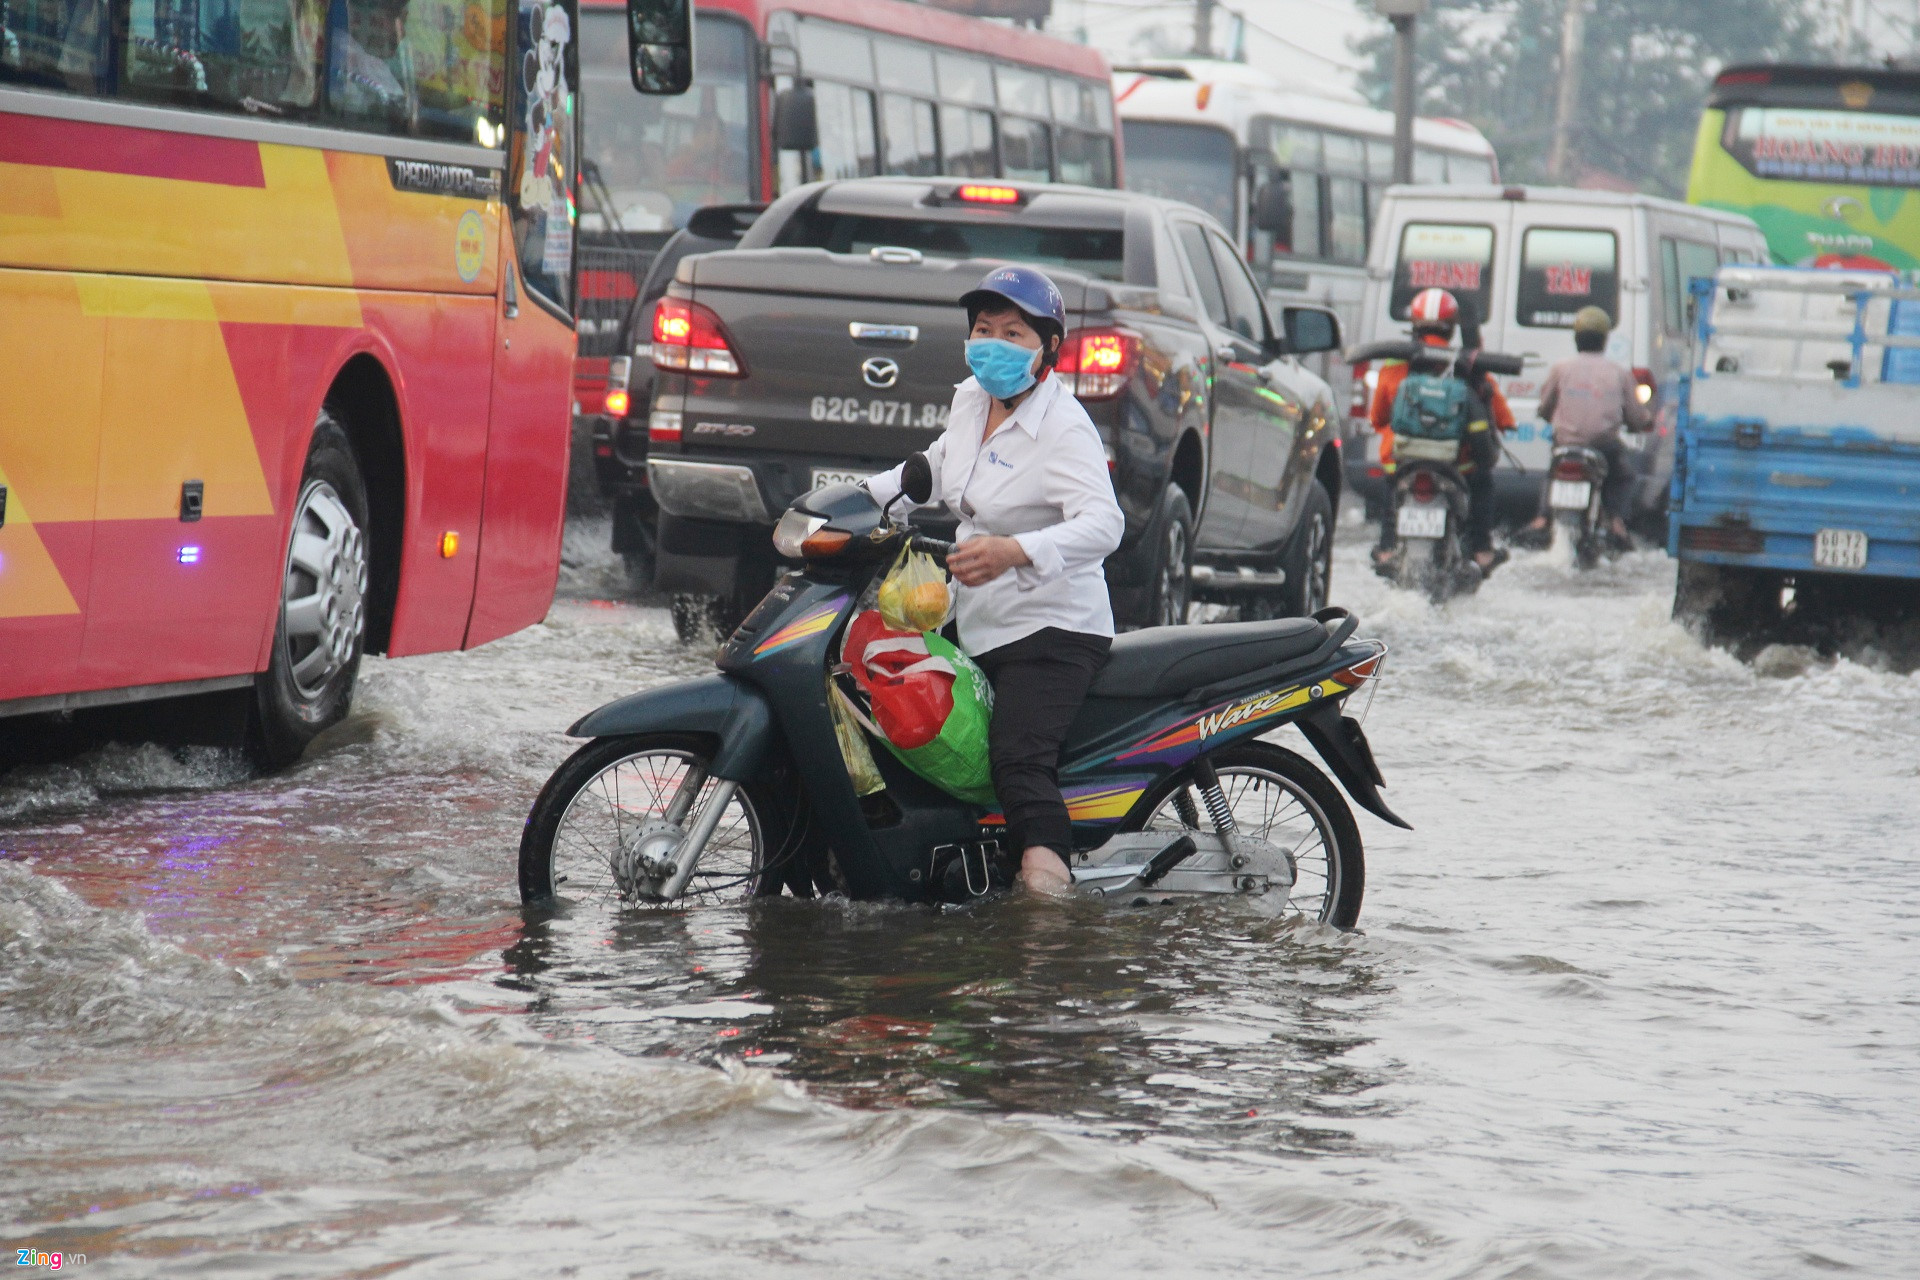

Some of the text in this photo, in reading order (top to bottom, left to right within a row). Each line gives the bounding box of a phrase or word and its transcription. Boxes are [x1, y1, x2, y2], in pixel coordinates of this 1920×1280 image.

[1410, 259, 1482, 291] THANH
[810, 395, 950, 429] 62C-071.84
[1239, 689, 1272, 704] HONDA
[1195, 691, 1294, 741] Wave
